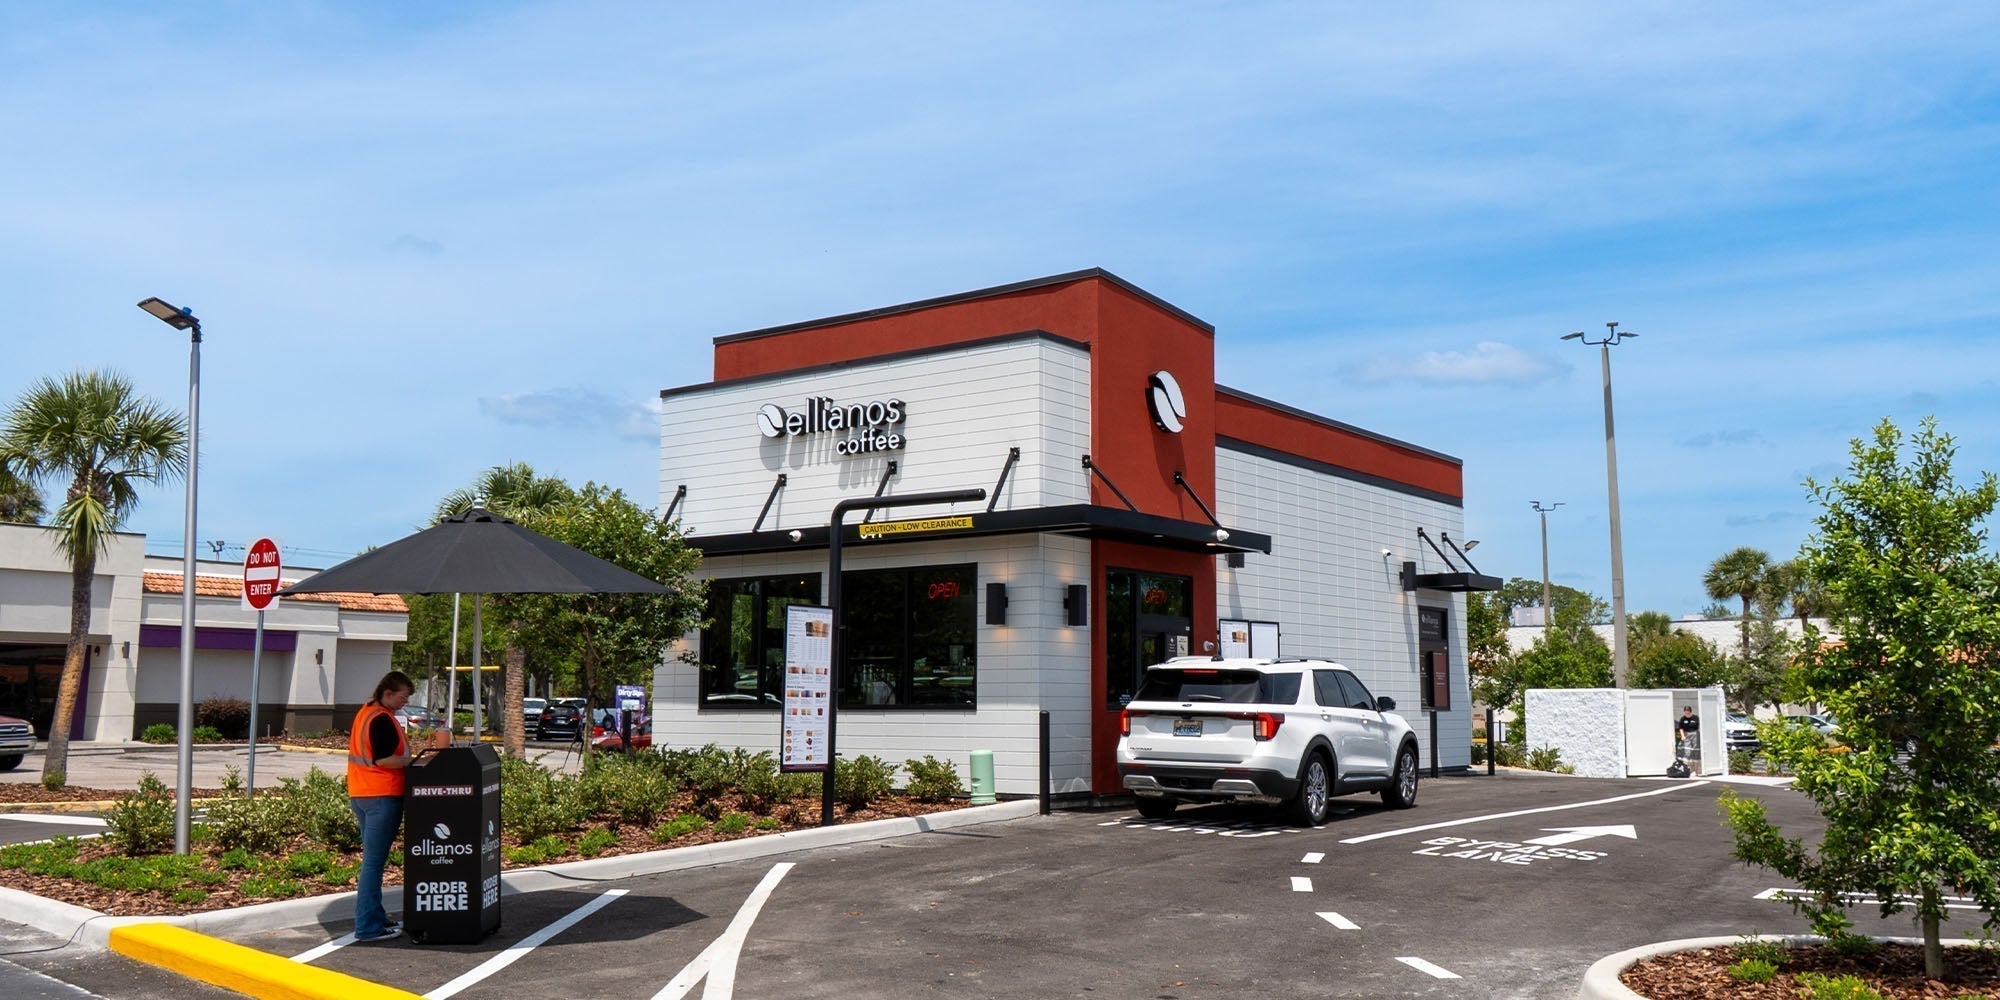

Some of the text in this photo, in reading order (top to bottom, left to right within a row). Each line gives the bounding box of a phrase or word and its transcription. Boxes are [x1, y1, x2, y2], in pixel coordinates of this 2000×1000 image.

[786, 396, 903, 436] ellianos
[836, 428, 902, 456] coffee
[864, 524, 897, 534] CAUTION
[902, 522, 920, 531] LOW
[921, 519, 967, 529] CLEARANCE
[250, 551, 276, 564] DO NOT
[250, 583, 272, 595] ENTER
[928, 582, 960, 600] OPEN
[1144, 588, 1168, 604] OPEN
[414, 787, 472, 796] DRIVE-THRU
[411, 839, 473, 855] ellianos
[1420, 836, 1608, 861] BYPASS
[430, 856, 454, 865] coffee
[1412, 846, 1550, 865] LANE
[416, 881, 468, 894] ORDER
[483, 874, 498, 892] ORDER
[416, 894, 468, 911] HERE
[482, 887, 498, 909] HERE
